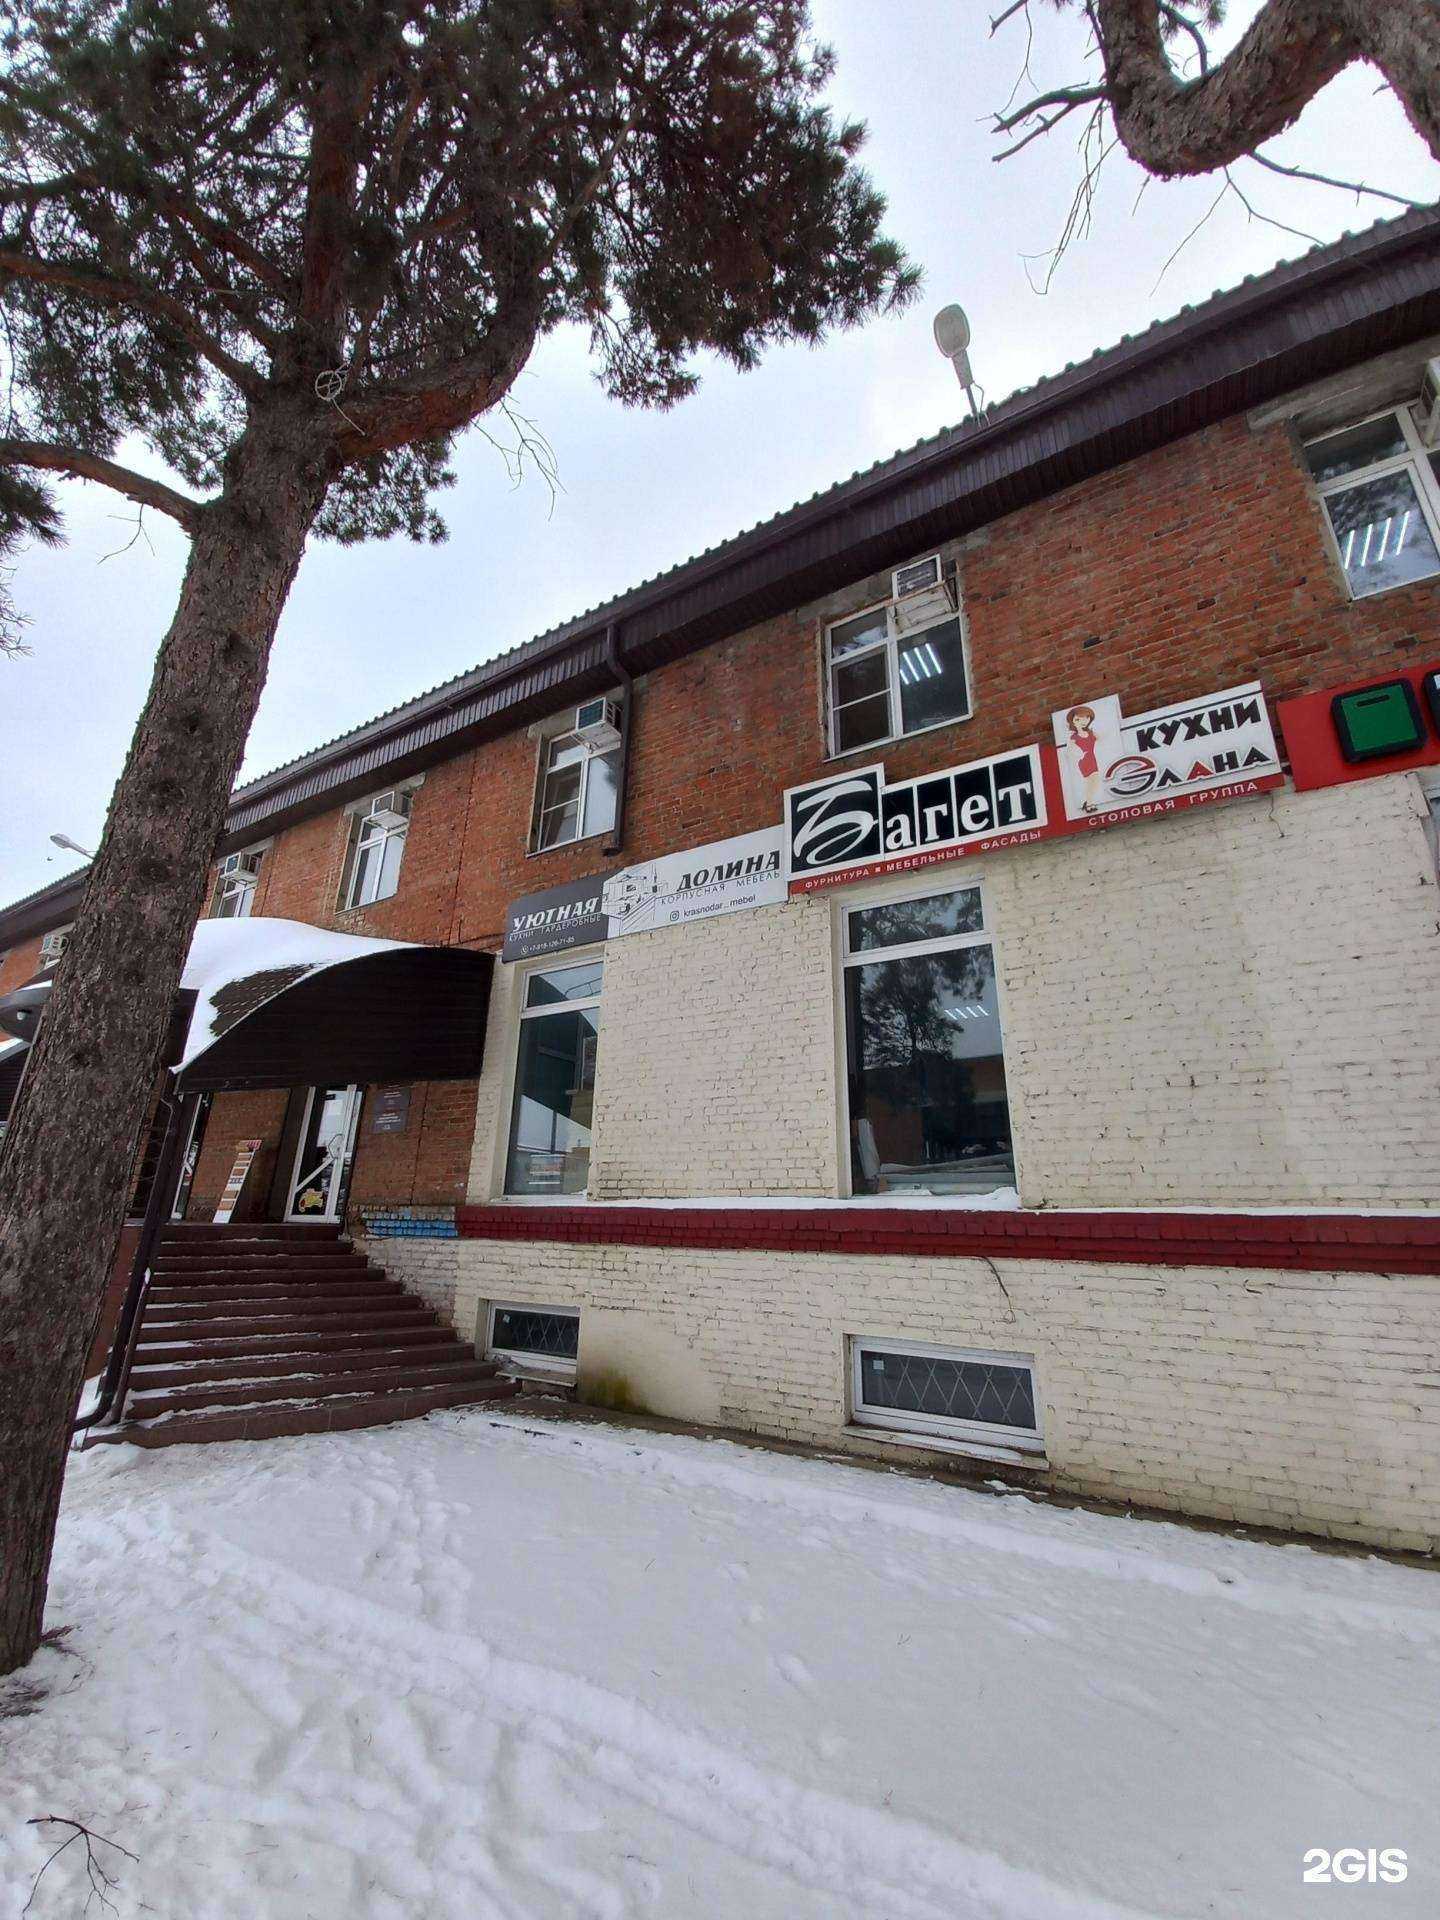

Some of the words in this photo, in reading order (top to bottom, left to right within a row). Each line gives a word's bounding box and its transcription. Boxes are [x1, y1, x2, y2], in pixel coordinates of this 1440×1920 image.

[1136, 699, 1261, 752] КУХНИ
[792, 779, 1032, 866] Багет
[1088, 799, 1175, 826] СТОЛОВАЯ
[1189, 781, 1258, 804] ГРУППА
[805, 868, 869, 888] ФУРНИТУРА
[886, 847, 965, 872] МЕБЕЛЬНЫЕ
[980, 831, 1041, 851] ФАСАДЫ
[513, 897, 599, 932] УЮТНАЯ
[677, 850, 780, 892] ДОЛИНА
[661, 883, 726, 905] КОРПУСНАЯ
[736, 870, 780, 887] МЕБЕЛЬ
[541, 914, 601, 933] ГАРДЕРОБНЫЕ
